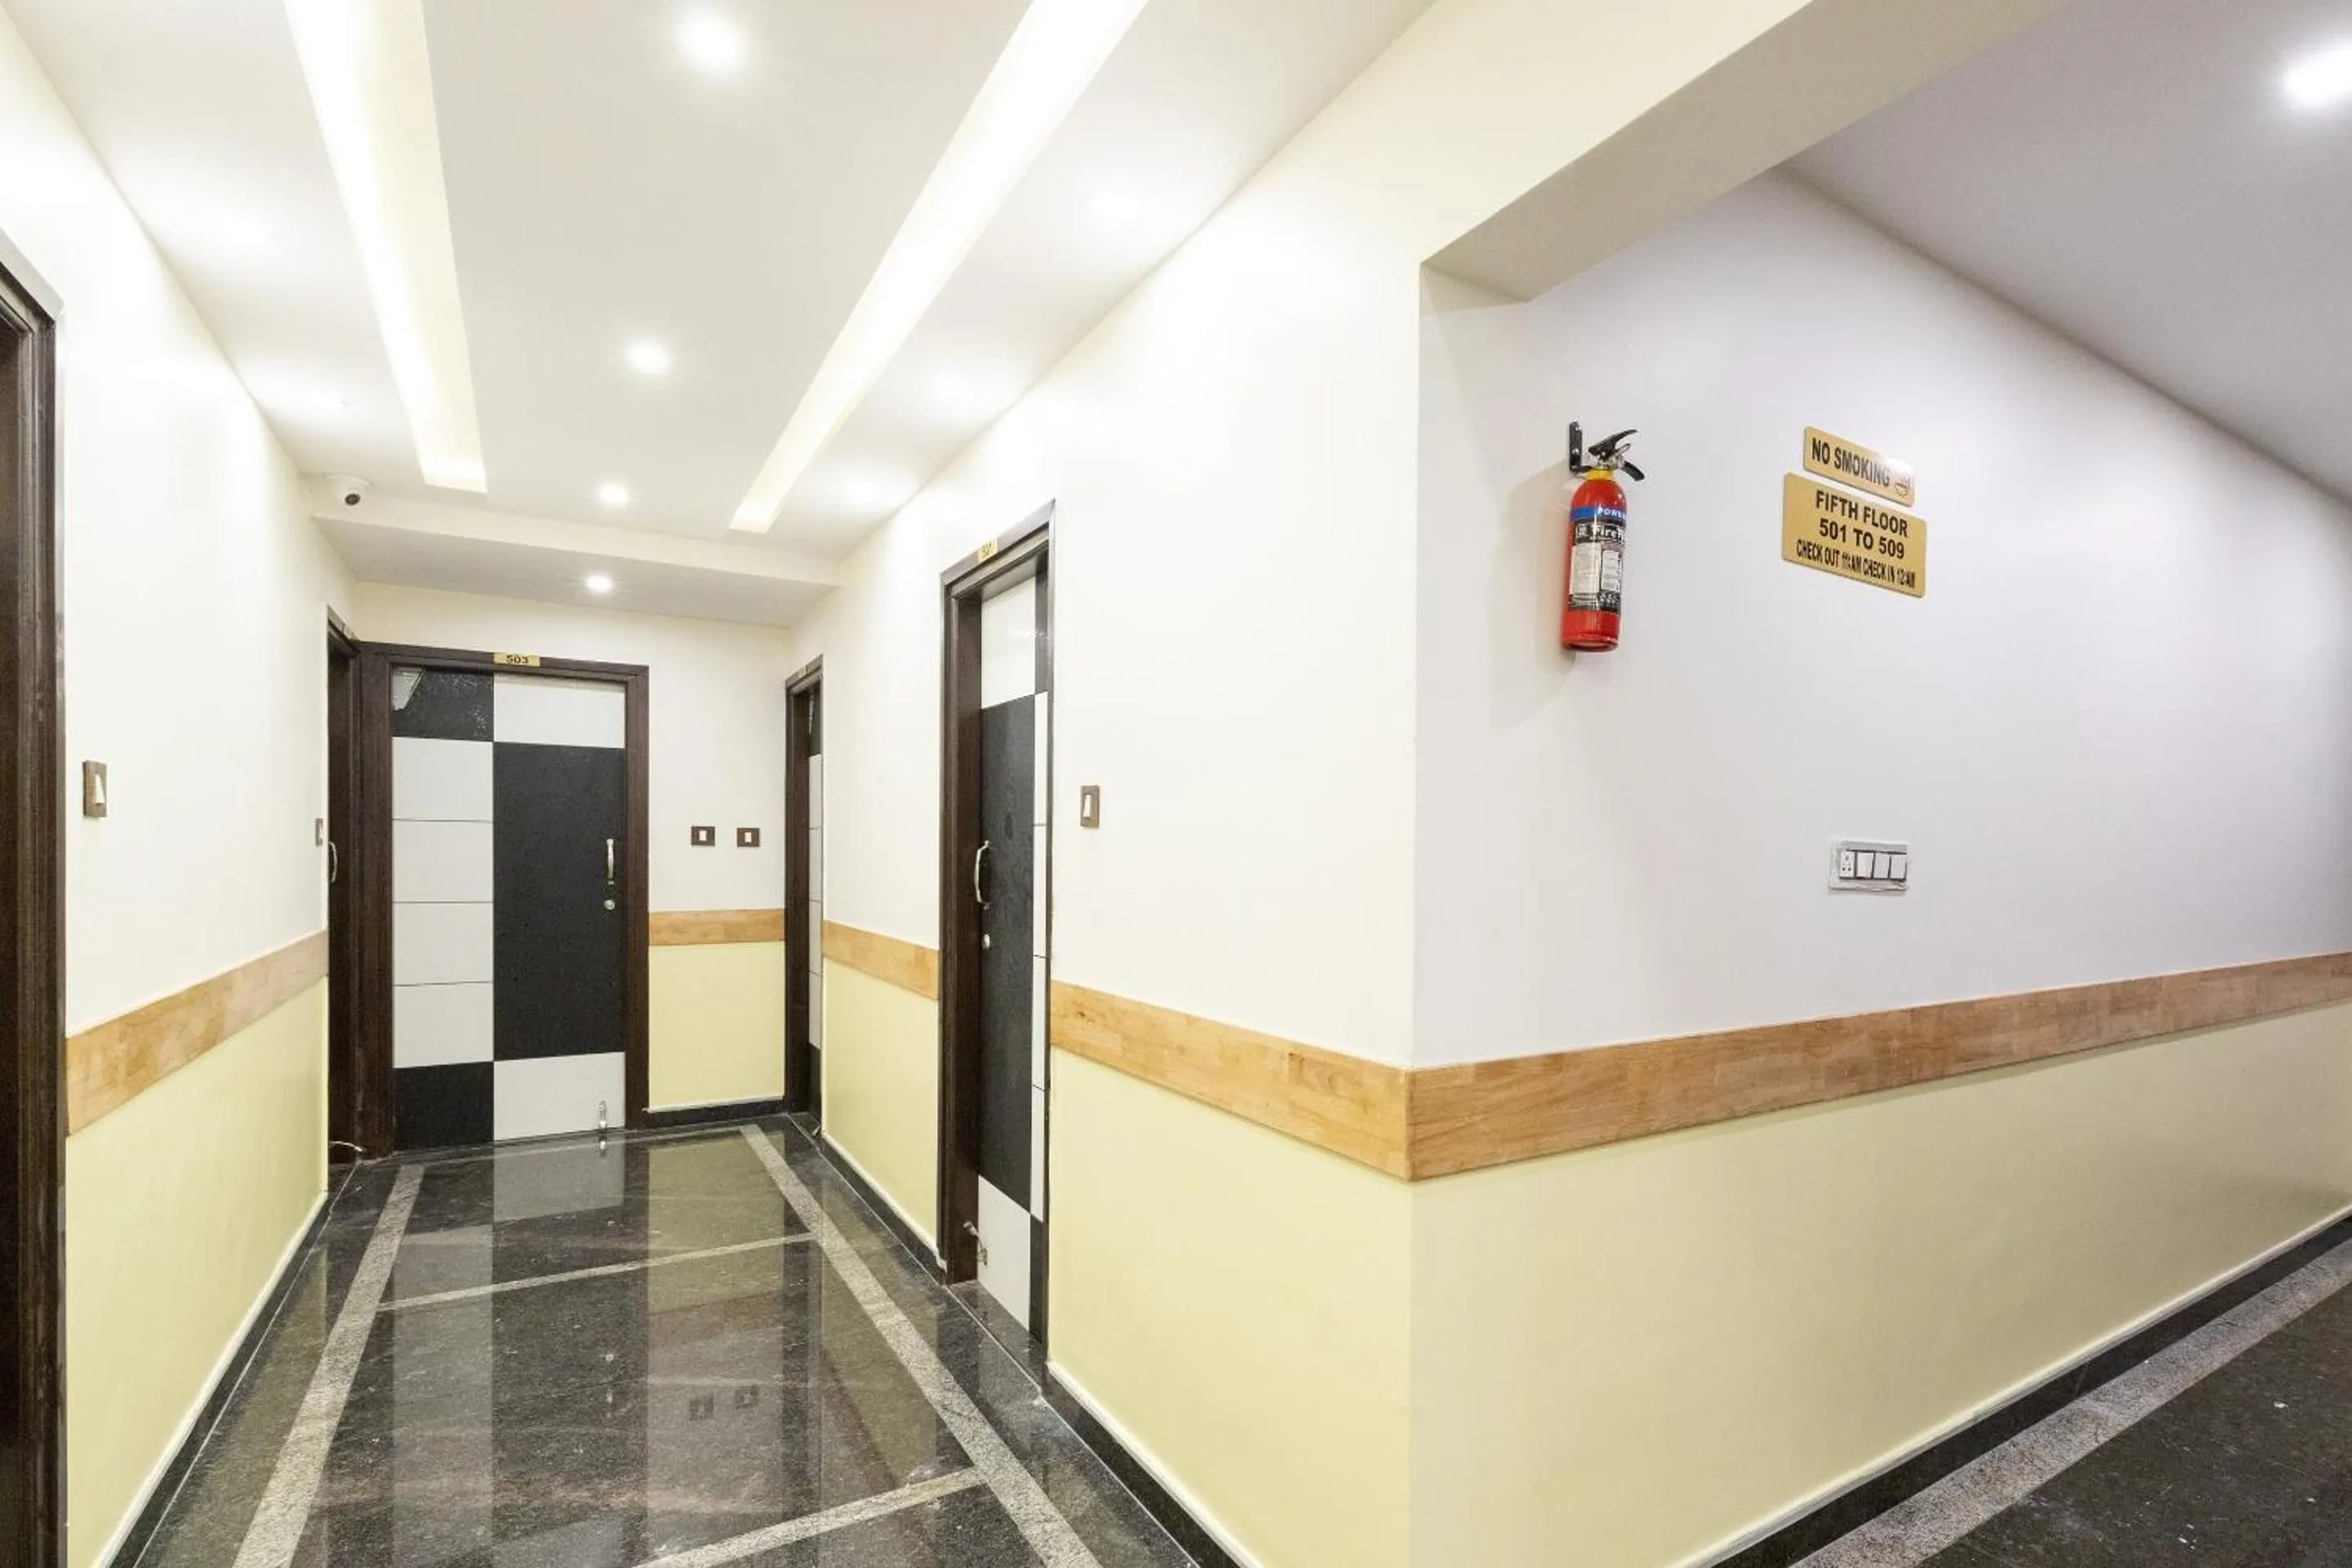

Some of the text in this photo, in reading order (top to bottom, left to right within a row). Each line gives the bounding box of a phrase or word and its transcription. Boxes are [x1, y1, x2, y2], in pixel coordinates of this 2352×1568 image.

[1811, 438, 1890, 487] NO SMOKING
[1815, 489, 1908, 537] FIFTH FLOOR
[1797, 539, 1823, 562] CHECK
[1824, 546, 1840, 568] OUT
[1863, 558, 1887, 581] CHECK
[1887, 564, 1895, 583] IN
[1819, 518, 1904, 559] 501 TO 509
